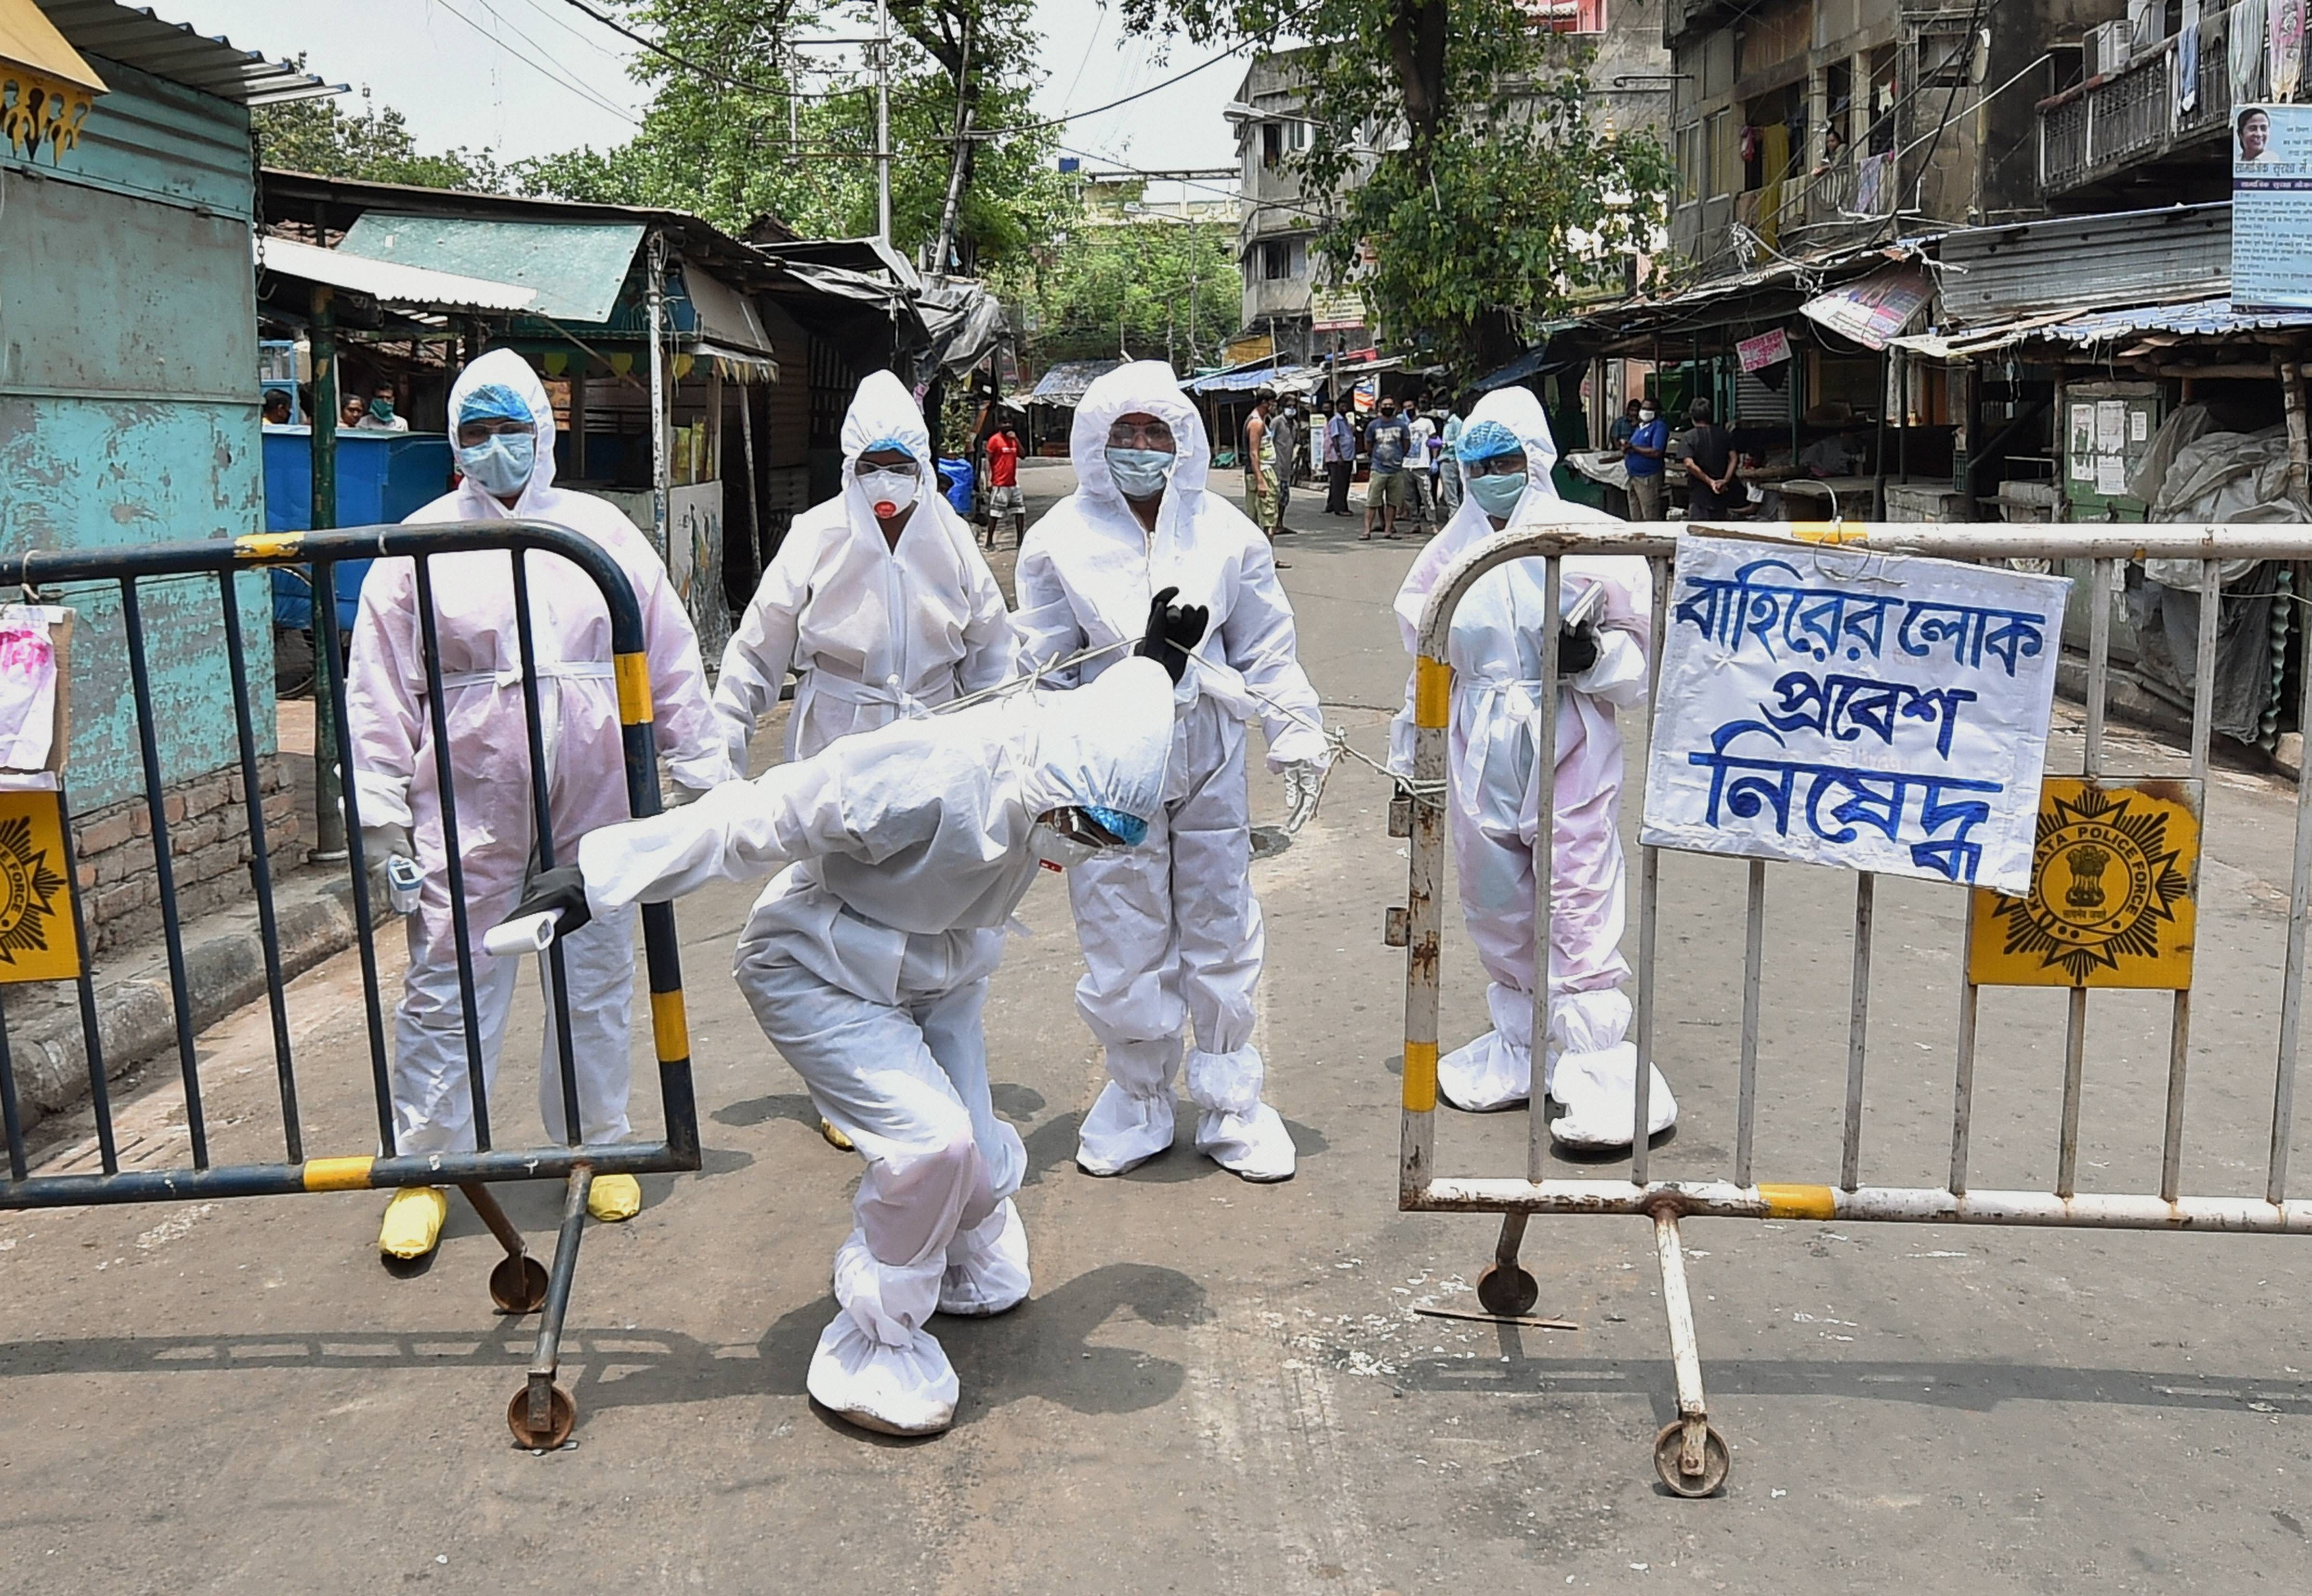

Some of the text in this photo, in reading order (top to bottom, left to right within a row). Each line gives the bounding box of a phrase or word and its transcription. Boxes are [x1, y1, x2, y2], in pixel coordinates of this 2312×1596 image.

[1676, 559, 2047, 678] বাহিরের লোক
[1758, 671, 1978, 761] প্রবেশ
[8, 863, 25, 913] FORCE
[2077, 826, 2139, 860] POLICE
[2125, 860, 2147, 916] FORCE
